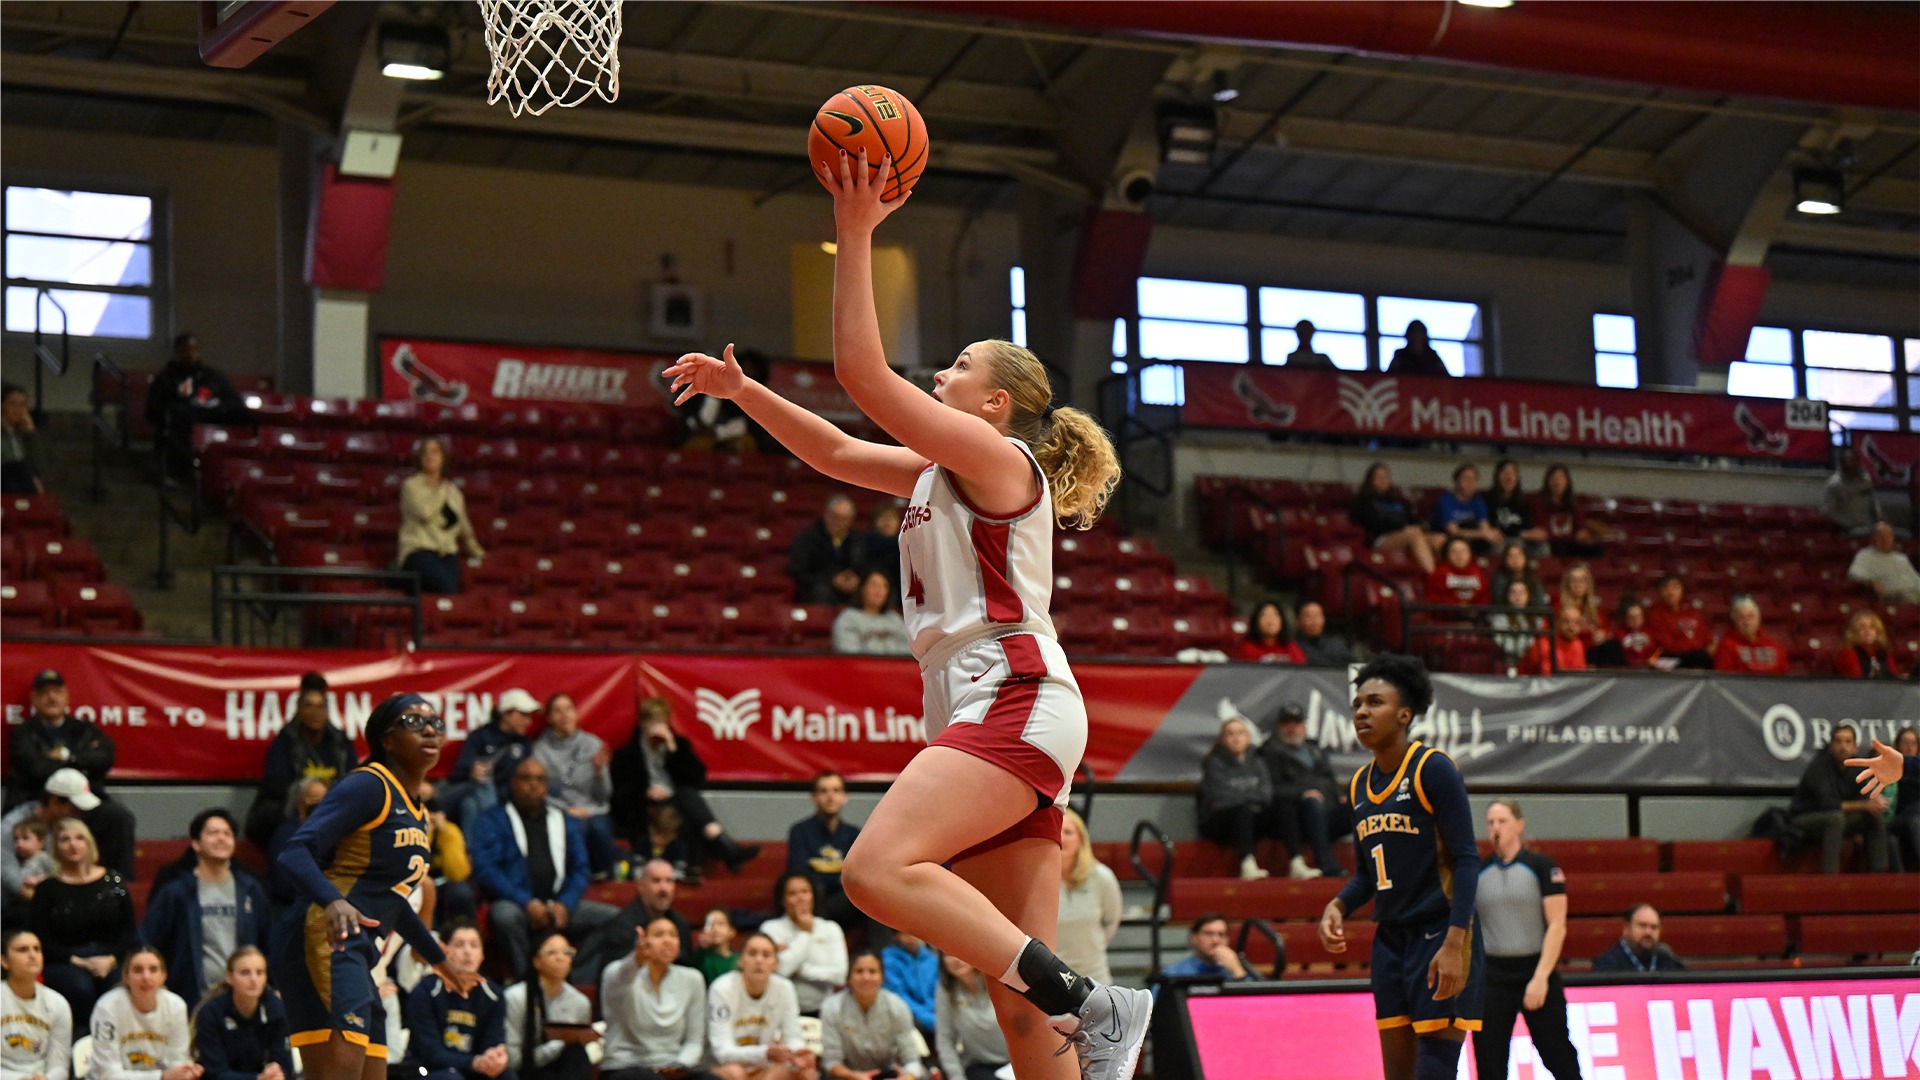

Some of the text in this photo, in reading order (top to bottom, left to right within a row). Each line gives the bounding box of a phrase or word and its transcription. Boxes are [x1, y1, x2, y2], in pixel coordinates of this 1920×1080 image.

[1411, 398, 1493, 436] Main
[1500, 403, 1571, 440] Line
[1790, 403, 1823, 421] 204
[5, 704, 147, 727] EOME
[164, 706, 206, 727] TO
[771, 705, 861, 742] Main
[1506, 724, 1681, 745] PHILADELPHIA
[1370, 843, 1393, 891] 1
